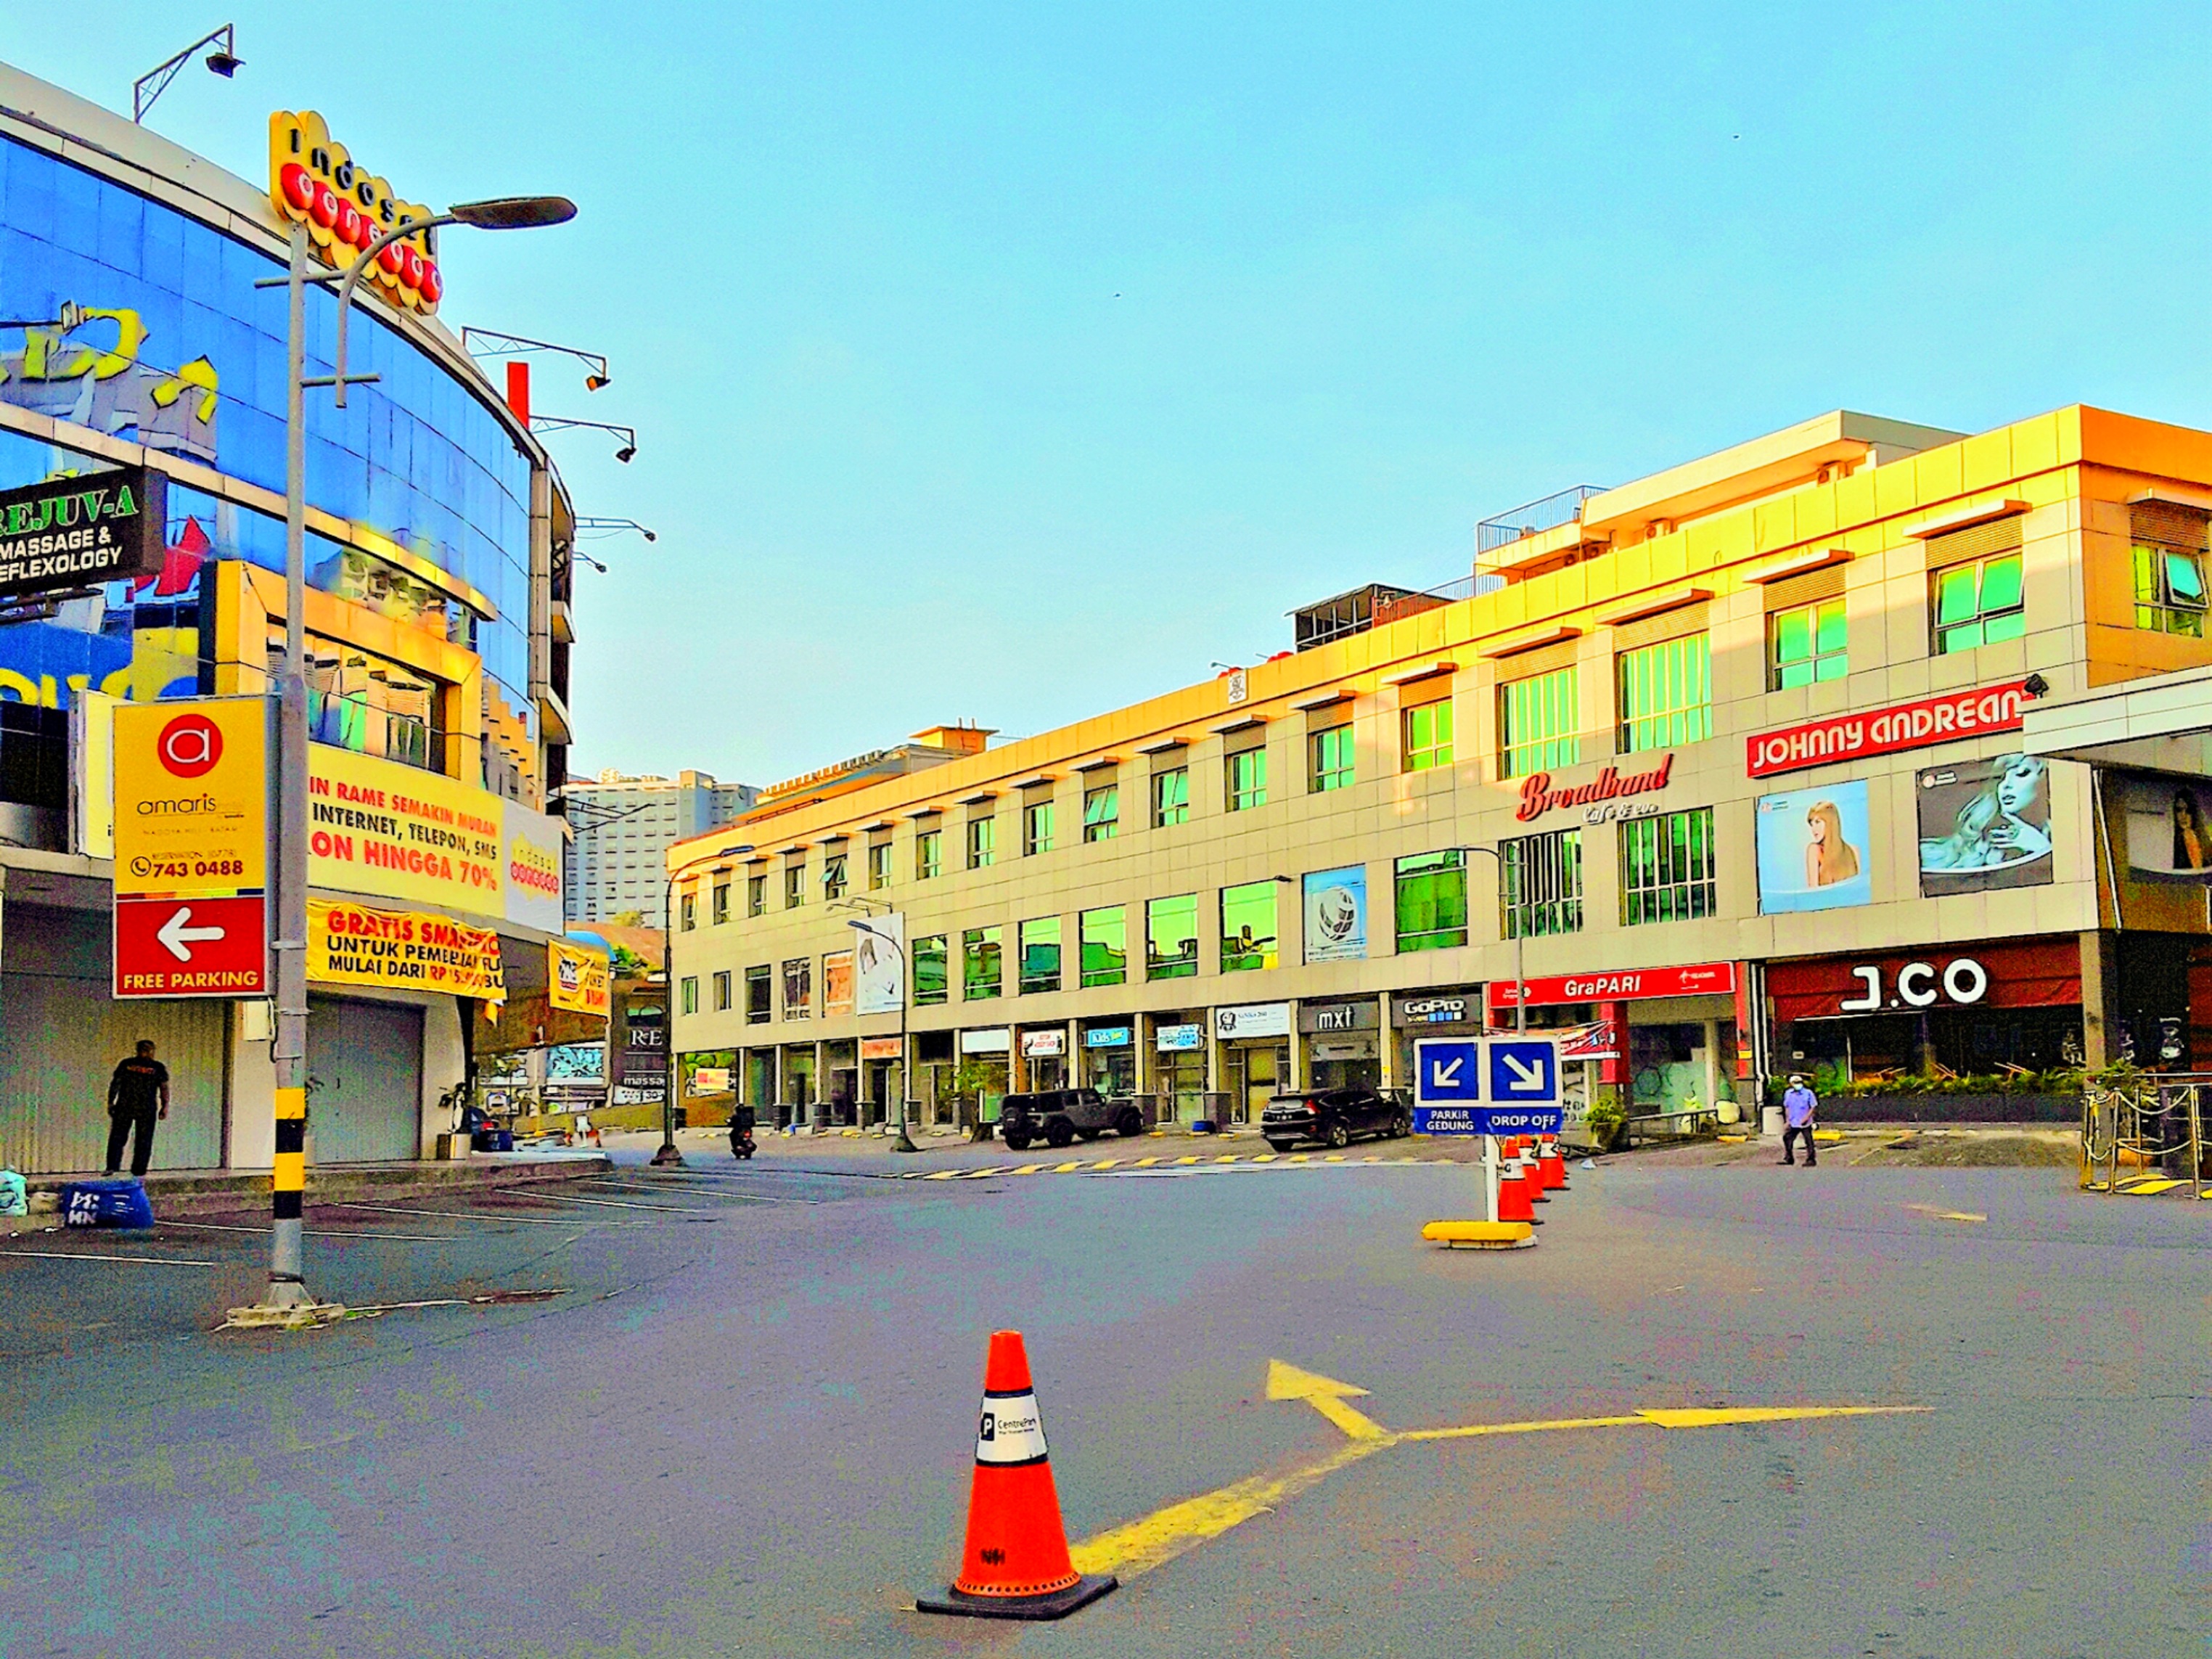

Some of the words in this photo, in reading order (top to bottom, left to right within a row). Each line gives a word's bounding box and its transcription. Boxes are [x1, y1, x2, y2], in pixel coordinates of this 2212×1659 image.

[0, 528, 94, 560] MASSAGE
[98, 525, 112, 545] &
[1515, 753, 1674, 822] Broadband
[137, 793, 216, 815] amaris
[337, 782, 385, 809] RAME
[391, 794, 453, 825] SEMAKIN
[312, 802, 404, 841] INTERNET,
[153, 862, 188, 878] 743
[194, 860, 243, 877] 0488
[364, 840, 453, 881] HINGGA
[459, 861, 497, 892] 70%
[328, 910, 413, 941] GRATIS
[327, 935, 398, 958] UNTUK
[329, 955, 382, 975] MULAI
[388, 961, 425, 978] DARI
[123, 973, 165, 989] FREE
[170, 970, 258, 988] PARKING
[1564, 975, 1642, 997] GraPARI
[1839, 957, 1988, 1011] J.CO
[1404, 999, 1465, 1015] GoPro
[1426, 1121, 1474, 1131] GEDUNG
[1430, 1110, 1470, 1120] PARKIR
[1491, 1115, 1528, 1126] DROP
[1531, 1114, 1557, 1130] OFF
